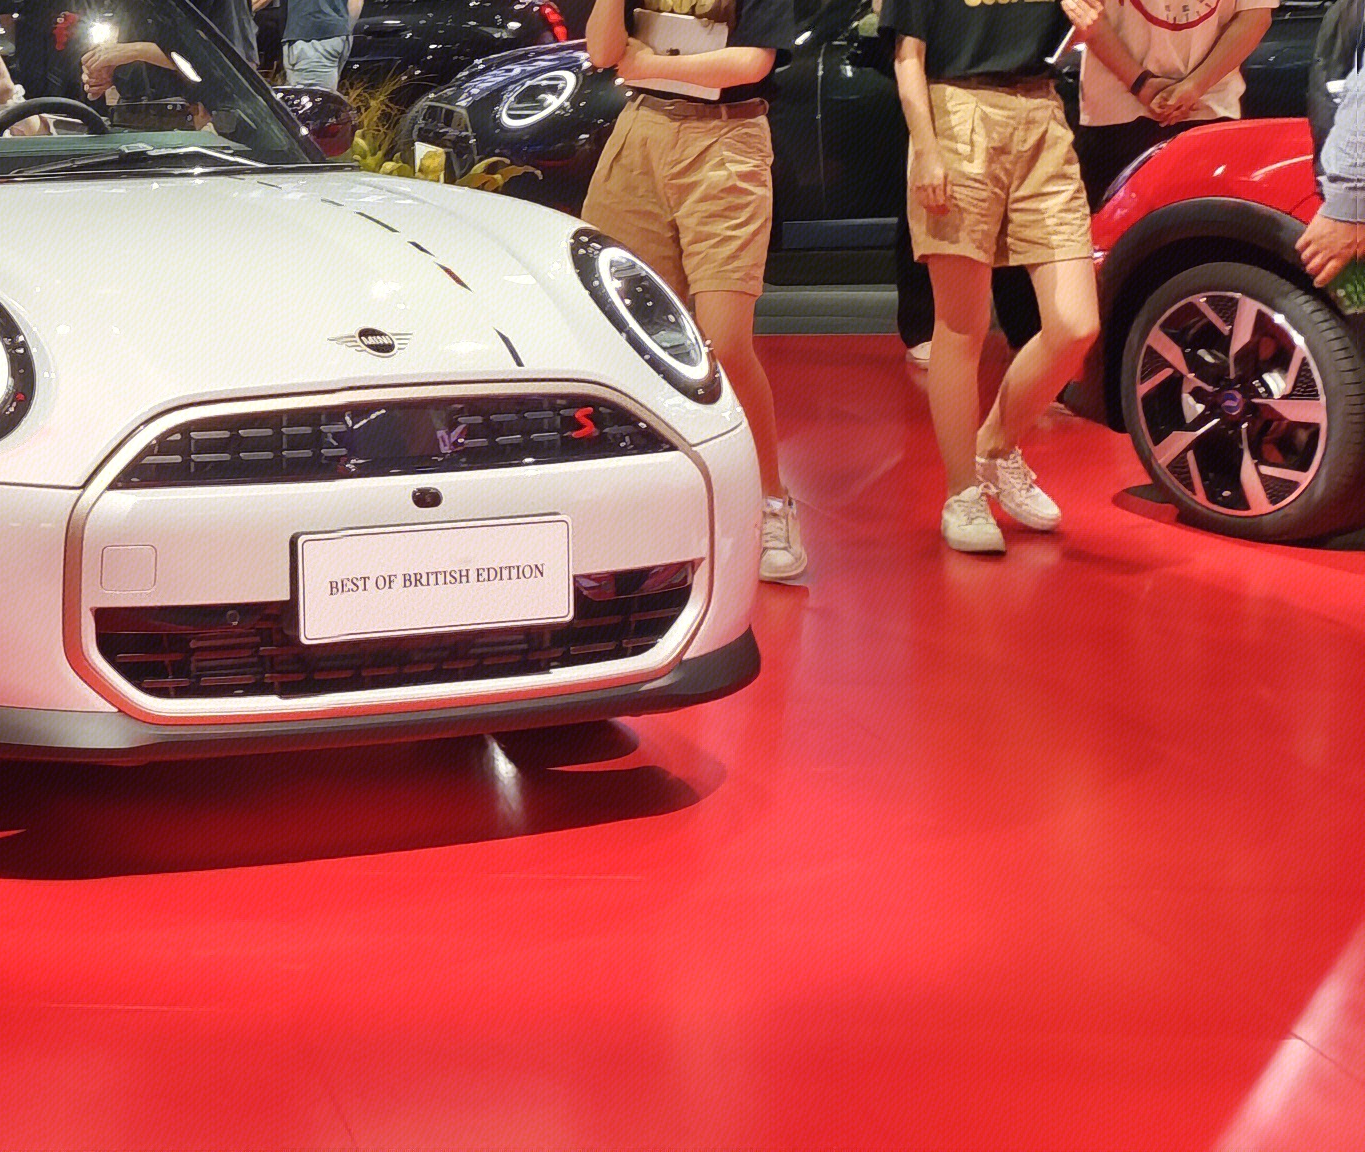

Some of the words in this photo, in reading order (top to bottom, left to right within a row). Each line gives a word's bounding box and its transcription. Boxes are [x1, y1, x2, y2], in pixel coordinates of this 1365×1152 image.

[328, 576, 370, 596] BEST
[375, 574, 397, 590] OF
[402, 568, 471, 589] BRITISH
[476, 562, 546, 583] EDITION
